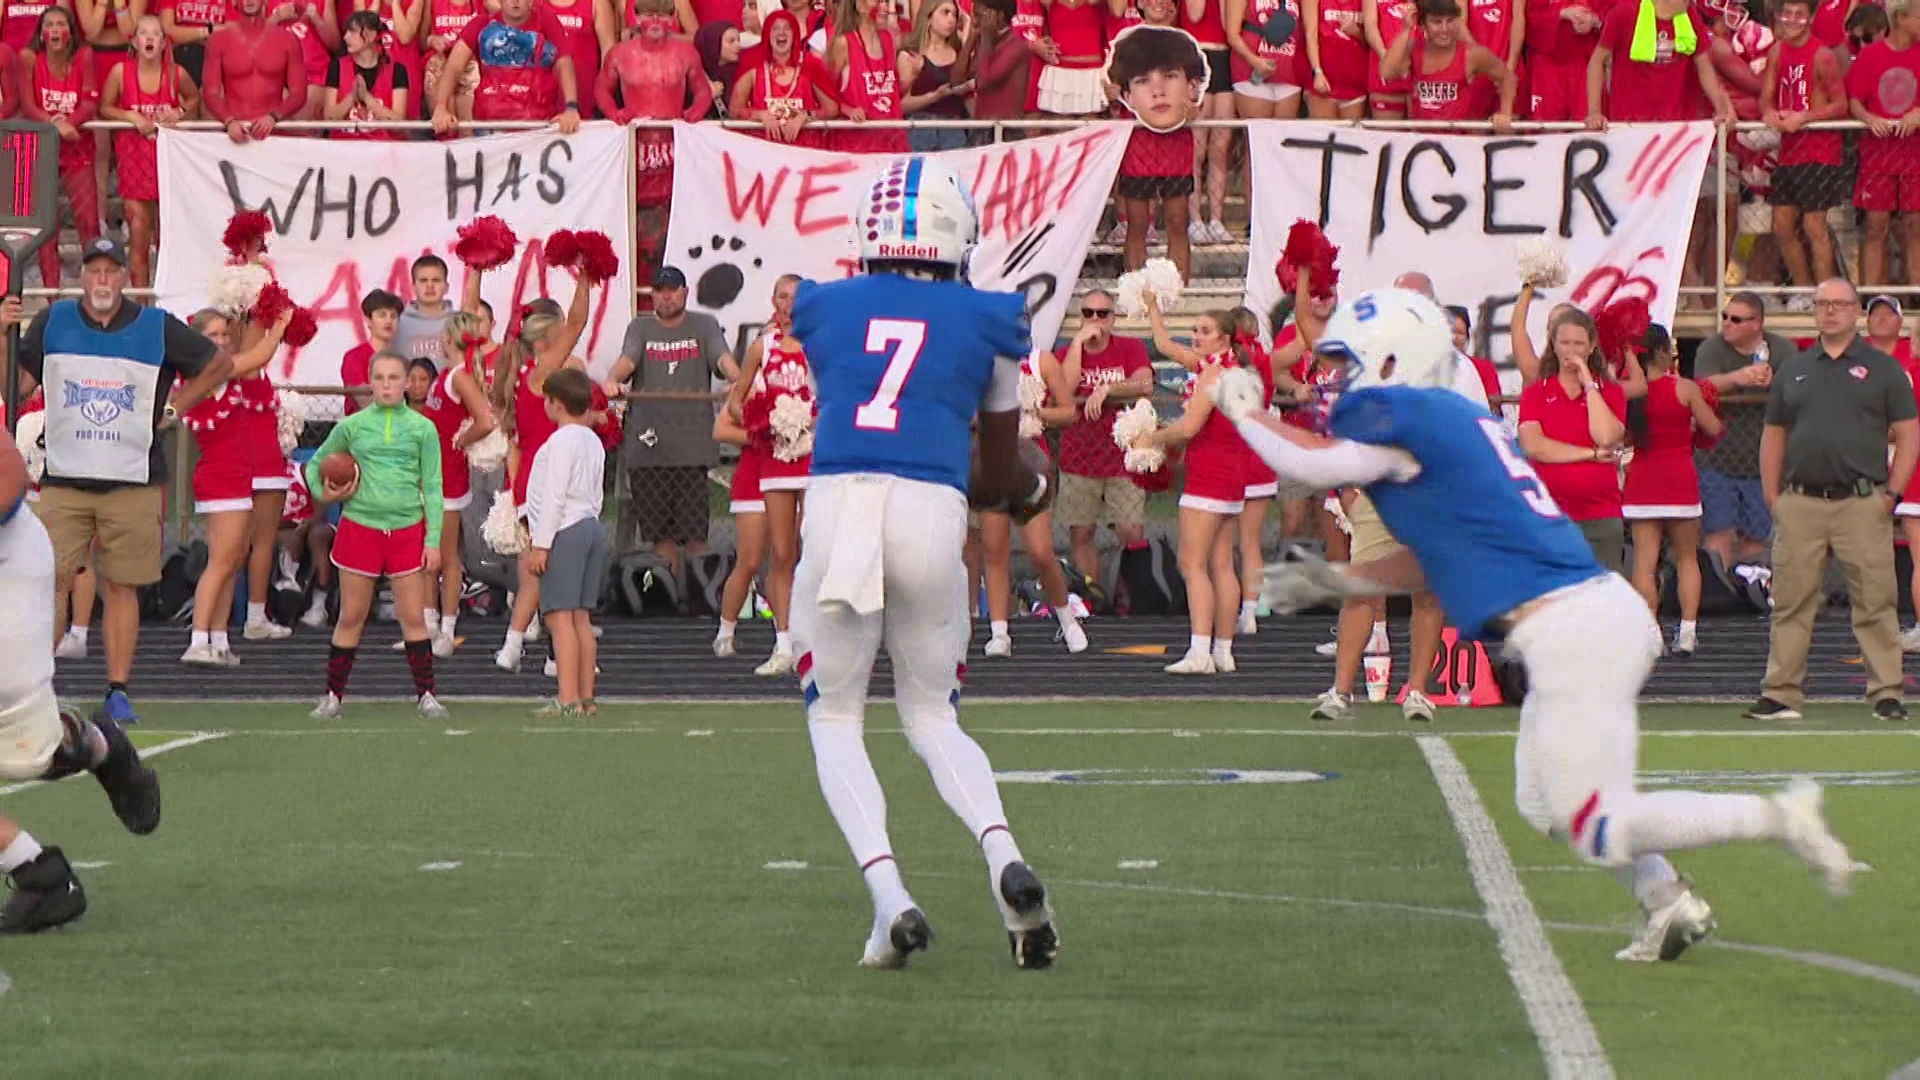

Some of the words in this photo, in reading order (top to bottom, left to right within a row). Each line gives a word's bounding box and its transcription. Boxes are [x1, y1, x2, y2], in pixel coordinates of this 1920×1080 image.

[1416, 81, 1458, 100] SHERS
[218, 159, 400, 241] WHO
[446, 138, 573, 220] HAS
[722, 150, 858, 237] WE
[970, 128, 1111, 243] ANT
[1281, 132, 1618, 256] TIGER
[879, 244, 939, 259] Riddell
[1353, 295, 1378, 322] S
[854, 317, 928, 432] 7
[1475, 417, 1563, 518] 5
[1424, 638, 1478, 696] 20
